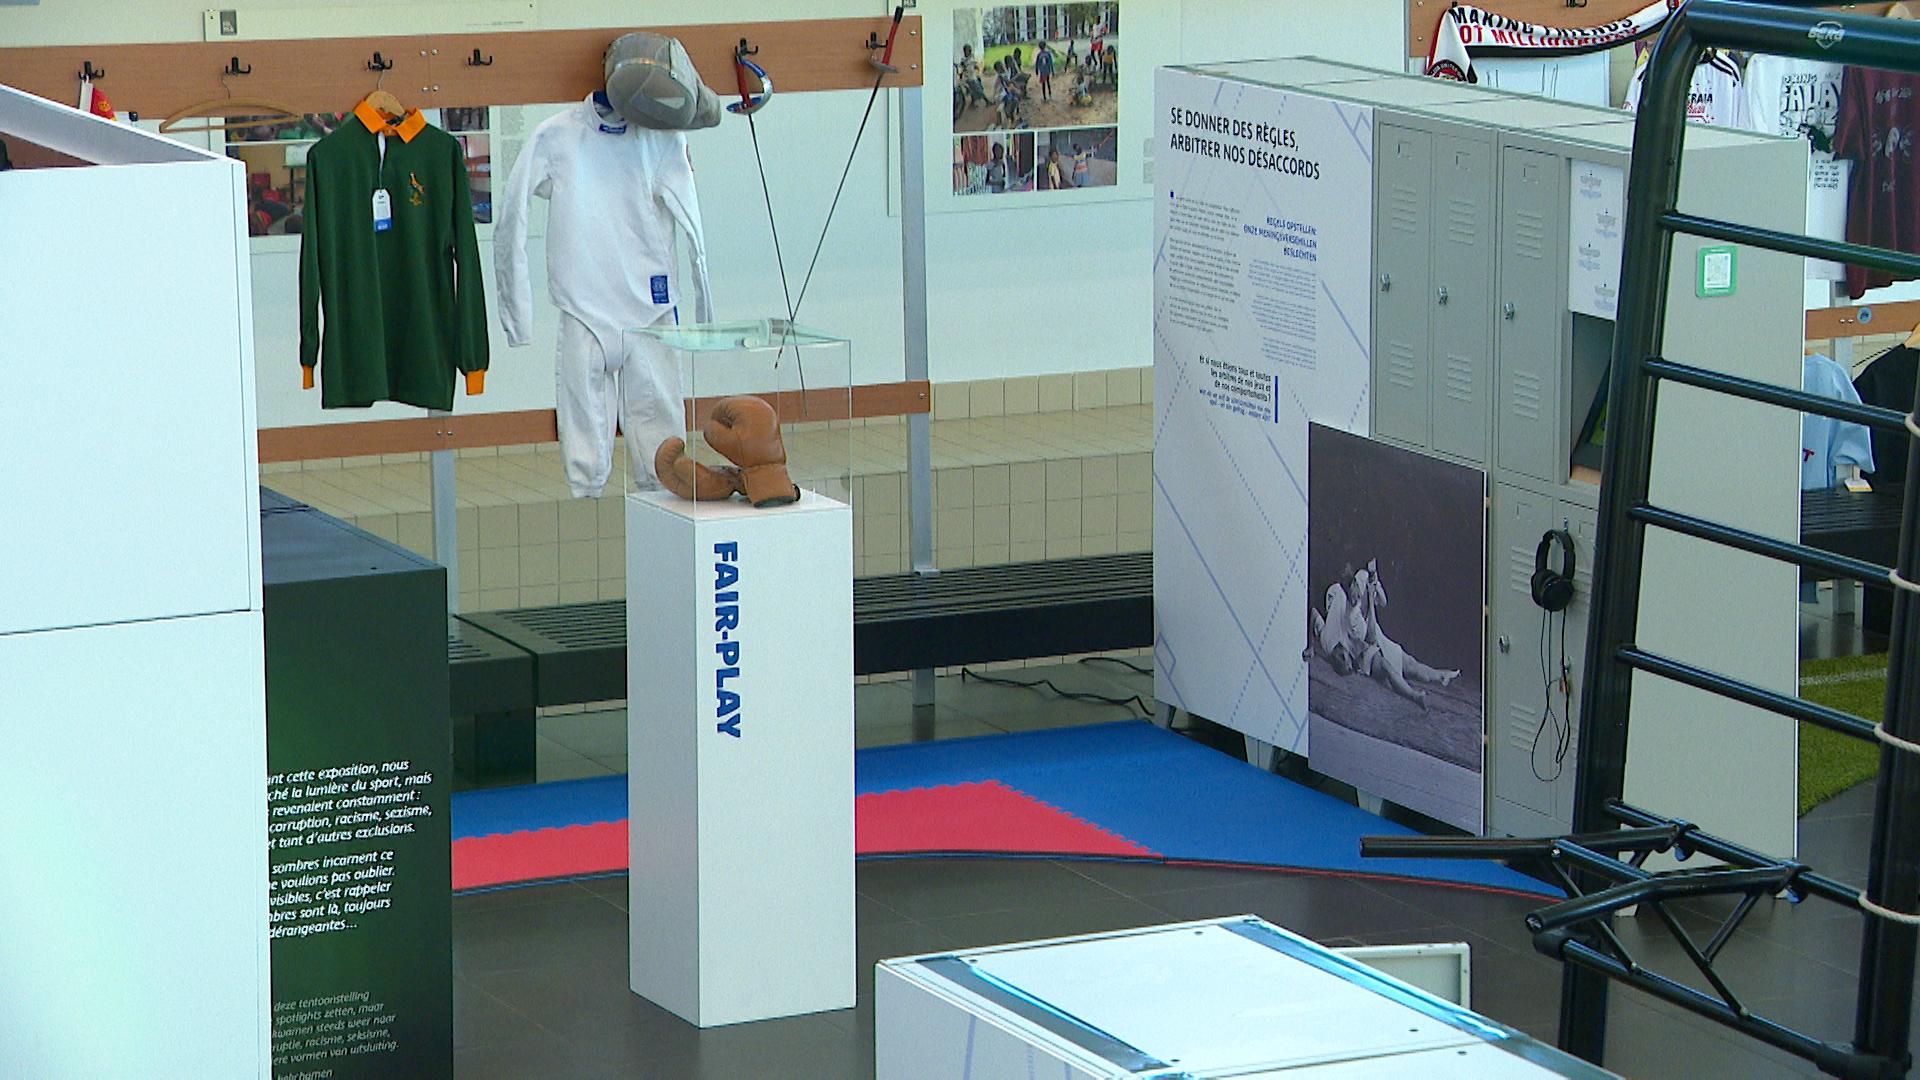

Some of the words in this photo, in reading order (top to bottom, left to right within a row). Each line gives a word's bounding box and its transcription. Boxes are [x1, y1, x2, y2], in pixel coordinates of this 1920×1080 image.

[1448, 7, 1534, 34] MAKING
[1171, 107, 1183, 125] SE
[1186, 110, 1229, 135] DONNER
[1233, 119, 1252, 139] DES
[1256, 121, 1299, 151] RÈGLES,
[1170, 133, 1220, 159] ARBITRER
[1224, 143, 1245, 164] NOS
[1249, 148, 1320, 180] DÉSACCORDS
[714, 541, 741, 738] FAIR-PLAY
[287, 770, 315, 784] cette
[318, 763, 379, 781] exposition,
[382, 760, 410, 772] nous
[291, 787, 303, 798] la
[305, 780, 349, 797] lumière
[351, 778, 367, 792] du
[369, 777, 402, 792] sport,
[404, 771, 433, 785] mais
[272, 798, 333, 817] revenaient
[336, 790, 415, 808] constamment
[269, 816, 332, 834] corruption,
[334, 810, 382, 826] racisme,
[385, 805, 433, 820] sexisme,
[279, 834, 303, 848] tant
[355, 822, 416, 839] exclusions.
[272, 858, 320, 875] sombres
[322, 852, 377, 868] incarnent
[380, 850, 394, 861] ce
[280, 874, 329, 890] voulions
[331, 871, 351, 886] pas
[353, 866, 395, 880] oublier.
[270, 891, 313, 907] visibles,
[344, 882, 392, 898] rappeler
[299, 904, 324, 918] sont
[327, 901, 341, 916] là,
[344, 898, 391, 914] toujours
[273, 1000, 296, 1013] deze
[299, 992, 370, 1009] tentoonstelling
[275, 1009, 322, 1026] spotlights
[324, 1006, 356, 1019] zetten,
[358, 1003, 384, 1014] maar
[272, 1025, 313, 1039] kwamen
[316, 1020, 345, 1033] steeds
[348, 1017, 371, 1028] weer
[373, 1014, 396, 1025] naar
[305, 1034, 345, 1048] racisme,
[347, 1028, 390, 1043] seksisme,
[290, 1051, 328, 1064] vormen
[330, 1047, 347, 1058] van
[350, 1039, 400, 1055] uitsluiting.
